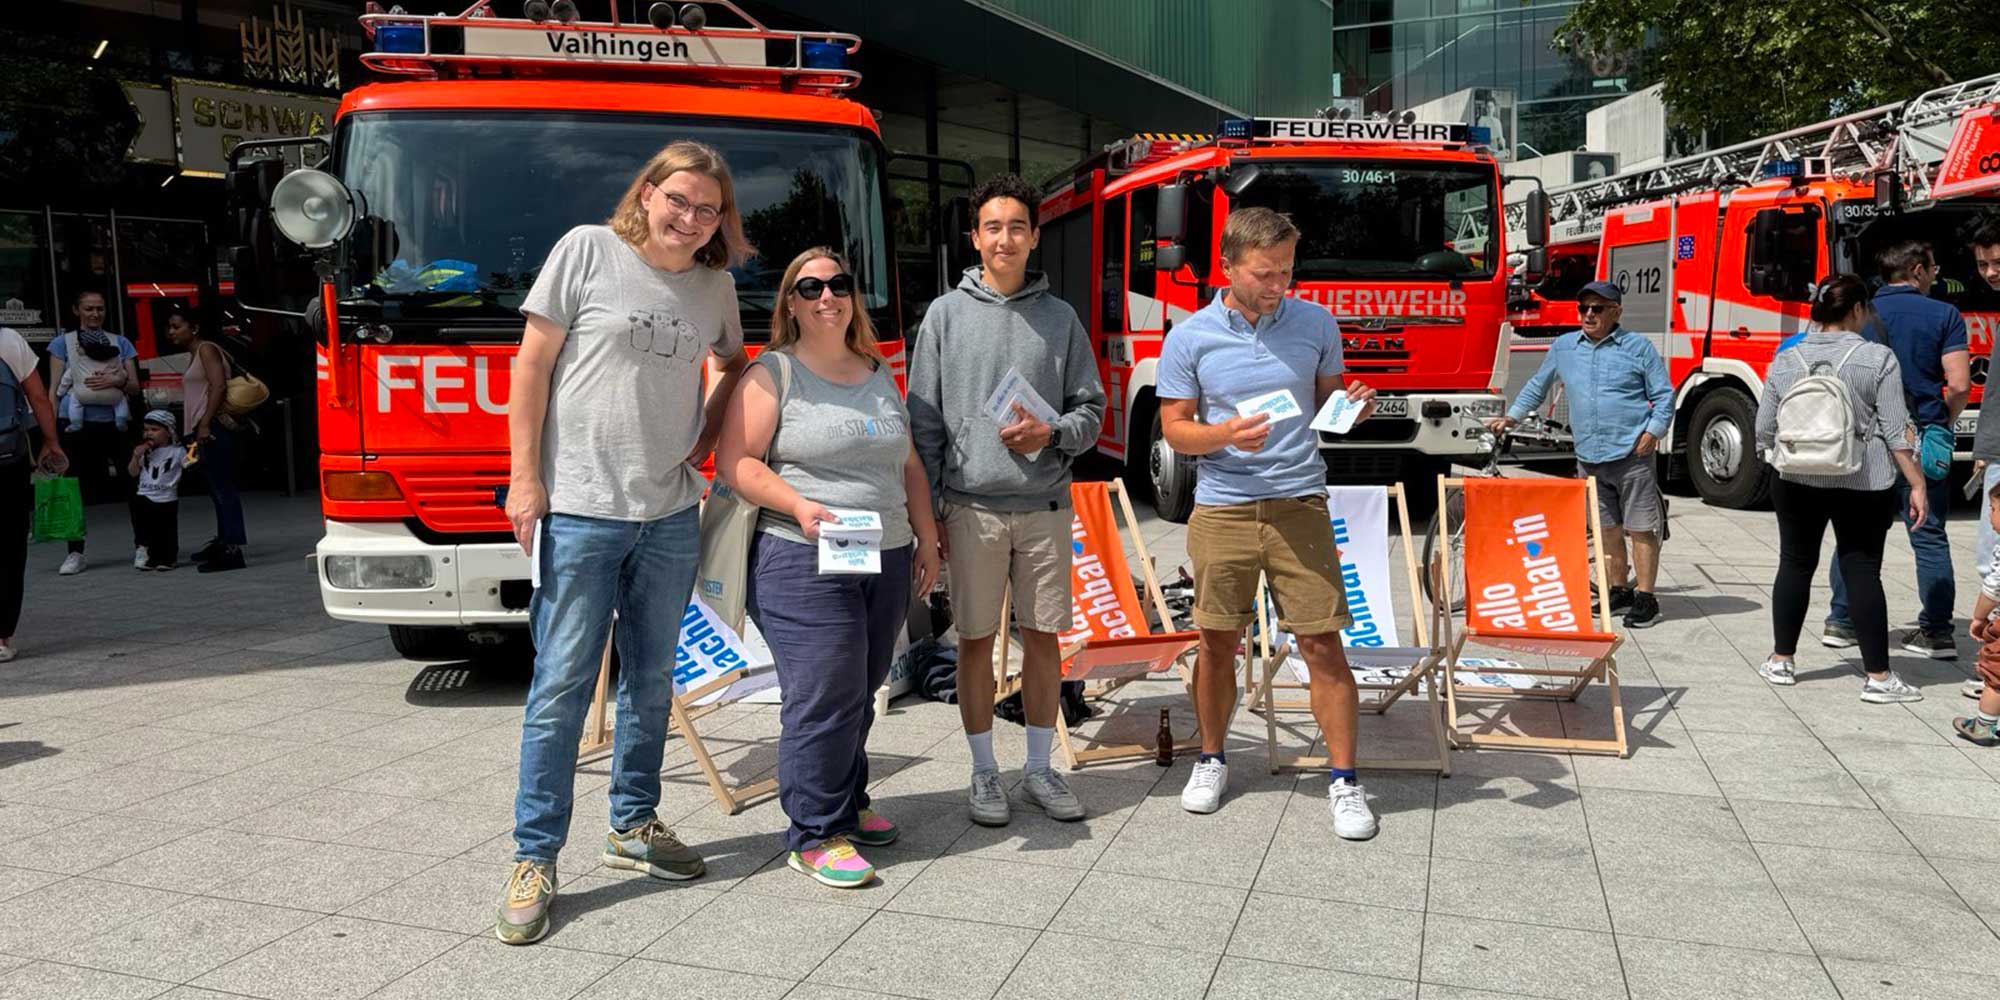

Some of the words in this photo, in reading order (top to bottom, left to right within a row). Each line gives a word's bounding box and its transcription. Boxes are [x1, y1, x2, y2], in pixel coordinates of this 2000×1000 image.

[547, 32, 689, 61] Vaihingen
[1273, 121, 1449, 140] FEUERWEHR
[1950, 121, 1977, 178] FEUERWEHR
[1342, 170, 1395, 183] 30/46-1
[1636, 267, 1661, 294] 112
[1285, 289, 1467, 316] UERWEHR
[1343, 338, 1404, 350] MAN
[377, 355, 515, 414] FEU
[1376, 401, 1405, 413] 2464
